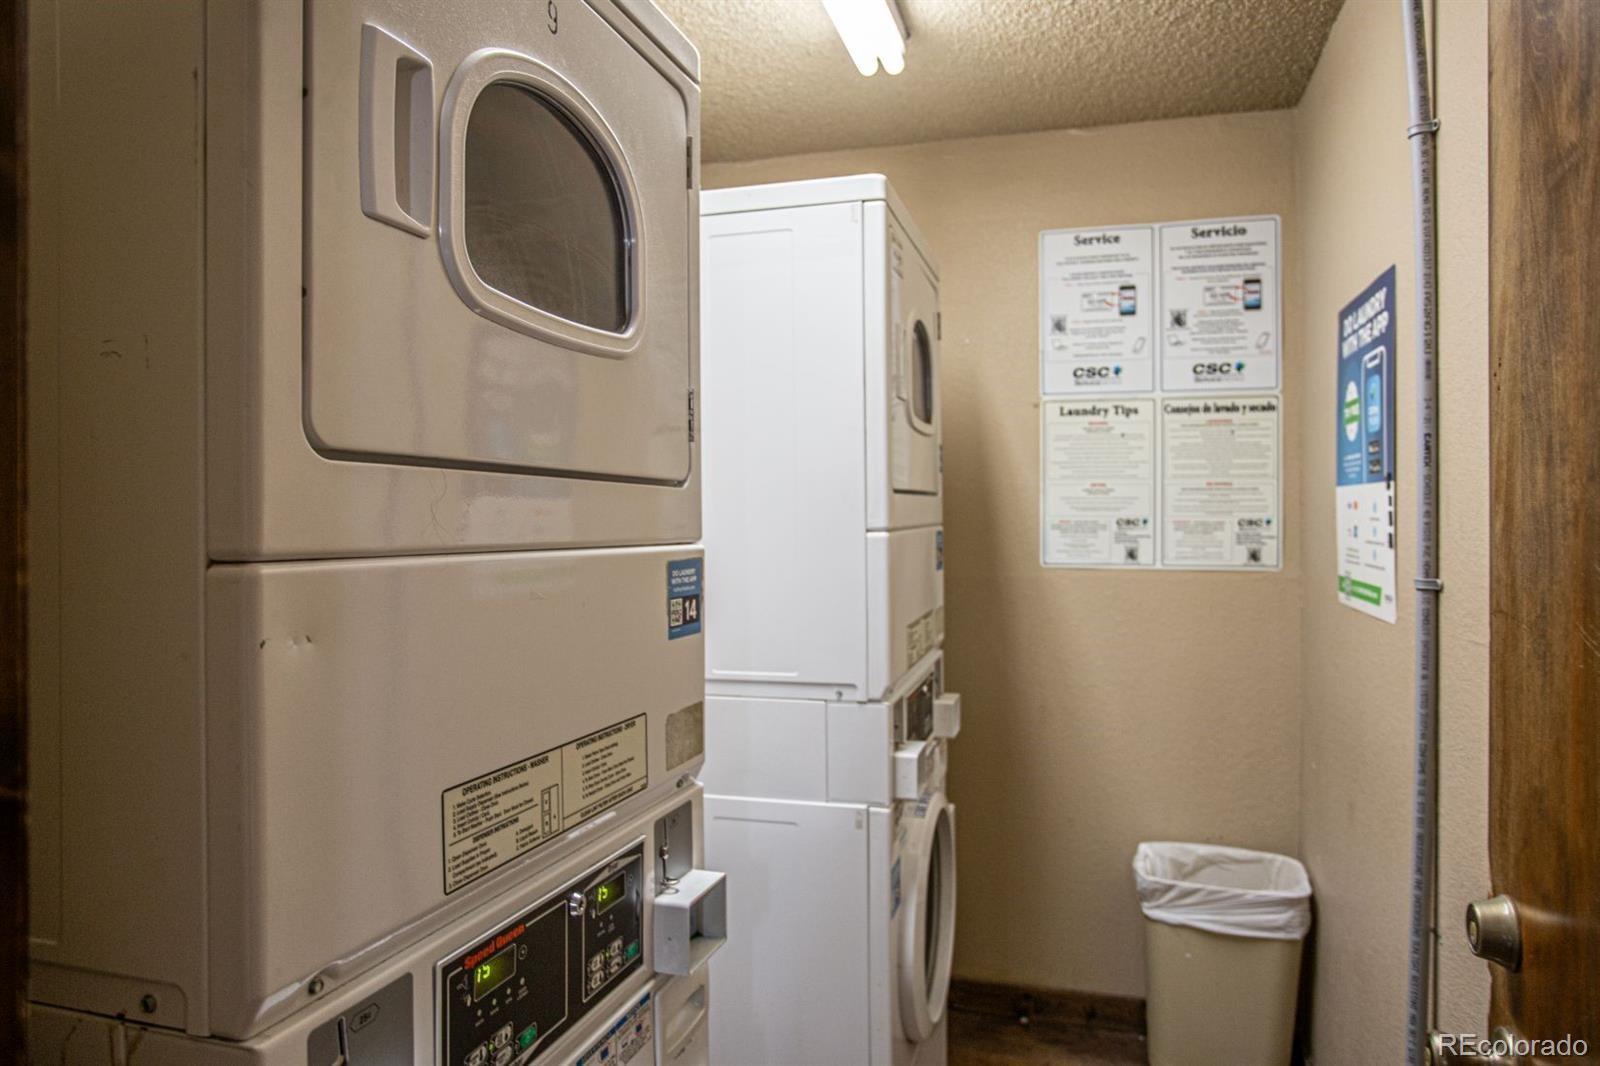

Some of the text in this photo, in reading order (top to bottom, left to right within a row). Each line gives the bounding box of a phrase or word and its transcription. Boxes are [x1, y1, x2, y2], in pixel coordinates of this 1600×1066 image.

[547, 0, 558, 35] 9
[1191, 225, 1247, 238] Servicio
[1074, 234, 1121, 246] Service
[1073, 366, 1110, 378] CSC
[1193, 363, 1232, 375] CSC
[1060, 405, 1139, 417] Laundry Tips
[1164, 402, 1277, 415] Consejos de lavado y secado
[685, 598, 697, 621] 14
[462, 778, 491, 796] OPERATING
[493, 764, 527, 783] INSTRUCTIONS
[530, 755, 549, 768] WASHER
[464, 924, 526, 970] Speed Queen
